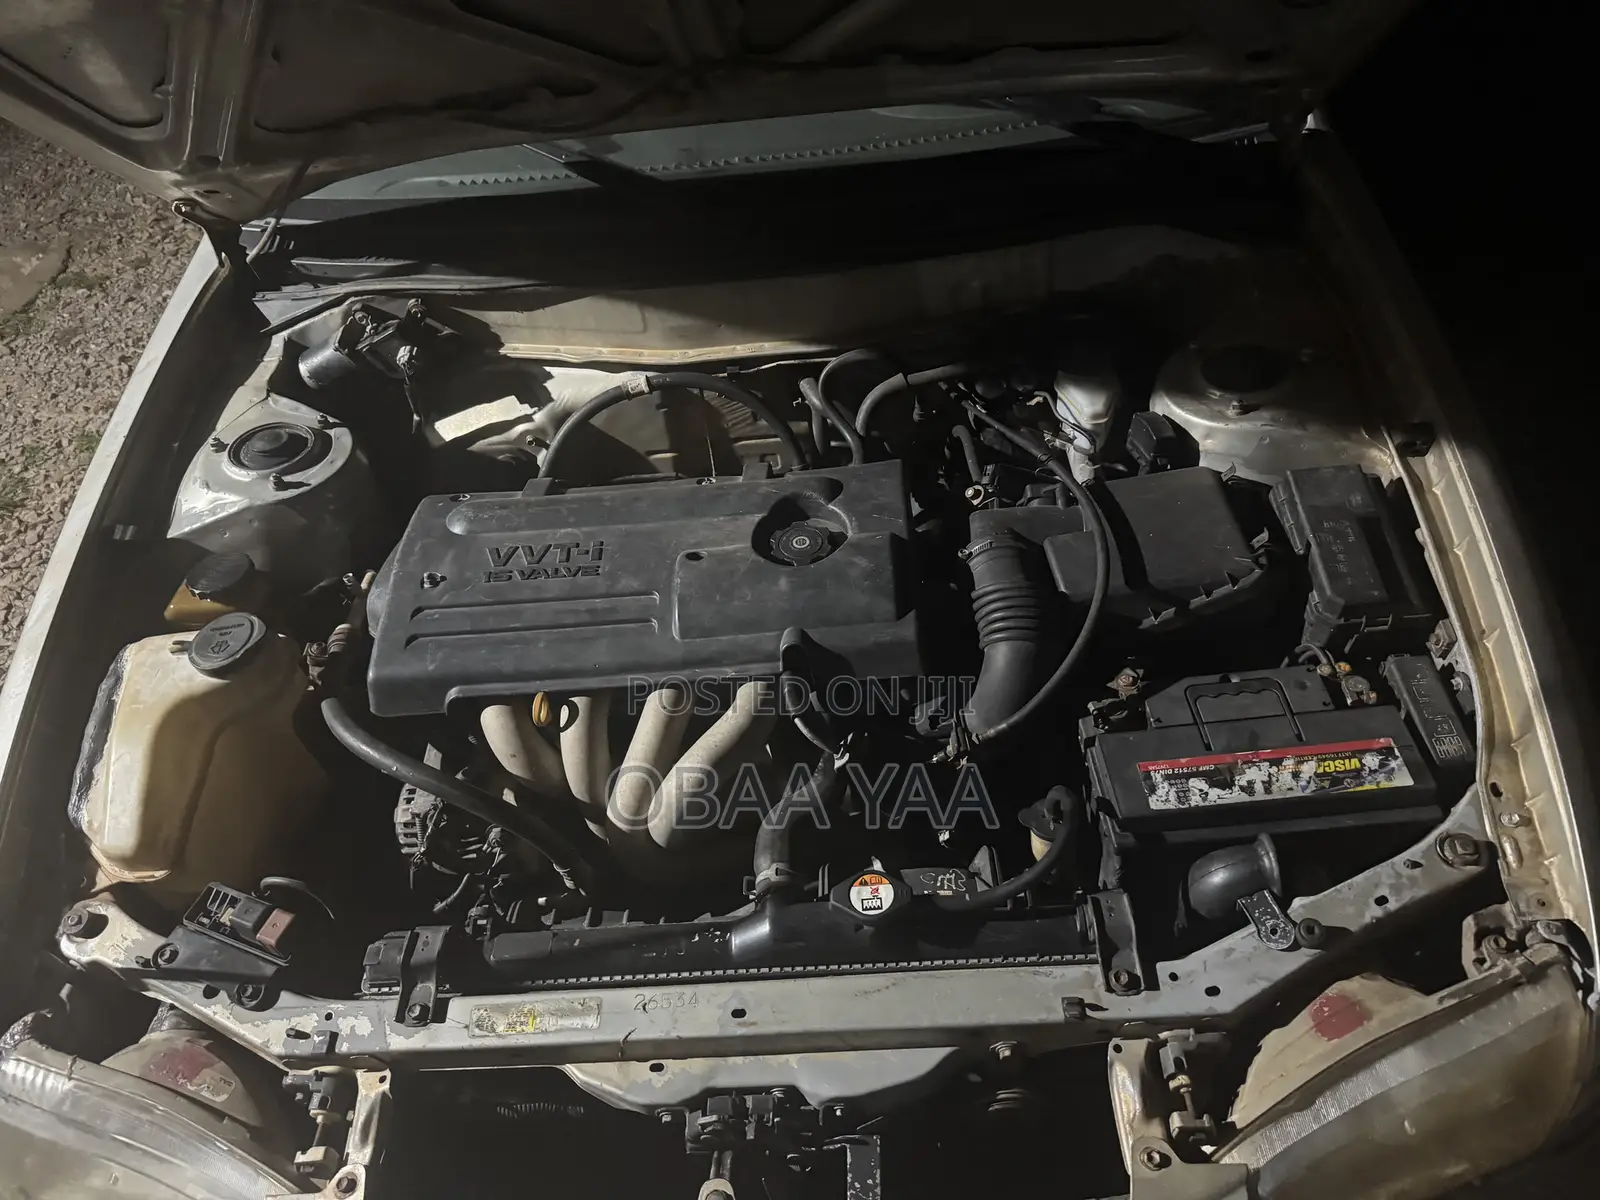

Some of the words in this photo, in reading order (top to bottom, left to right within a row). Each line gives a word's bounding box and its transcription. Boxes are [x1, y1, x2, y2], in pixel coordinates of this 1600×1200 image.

[486, 540, 604, 567] VVT-i
[514, 565, 601, 581] VALVE
[1174, 766, 1197, 774] 57512
[633, 991, 698, 1010] 26534
